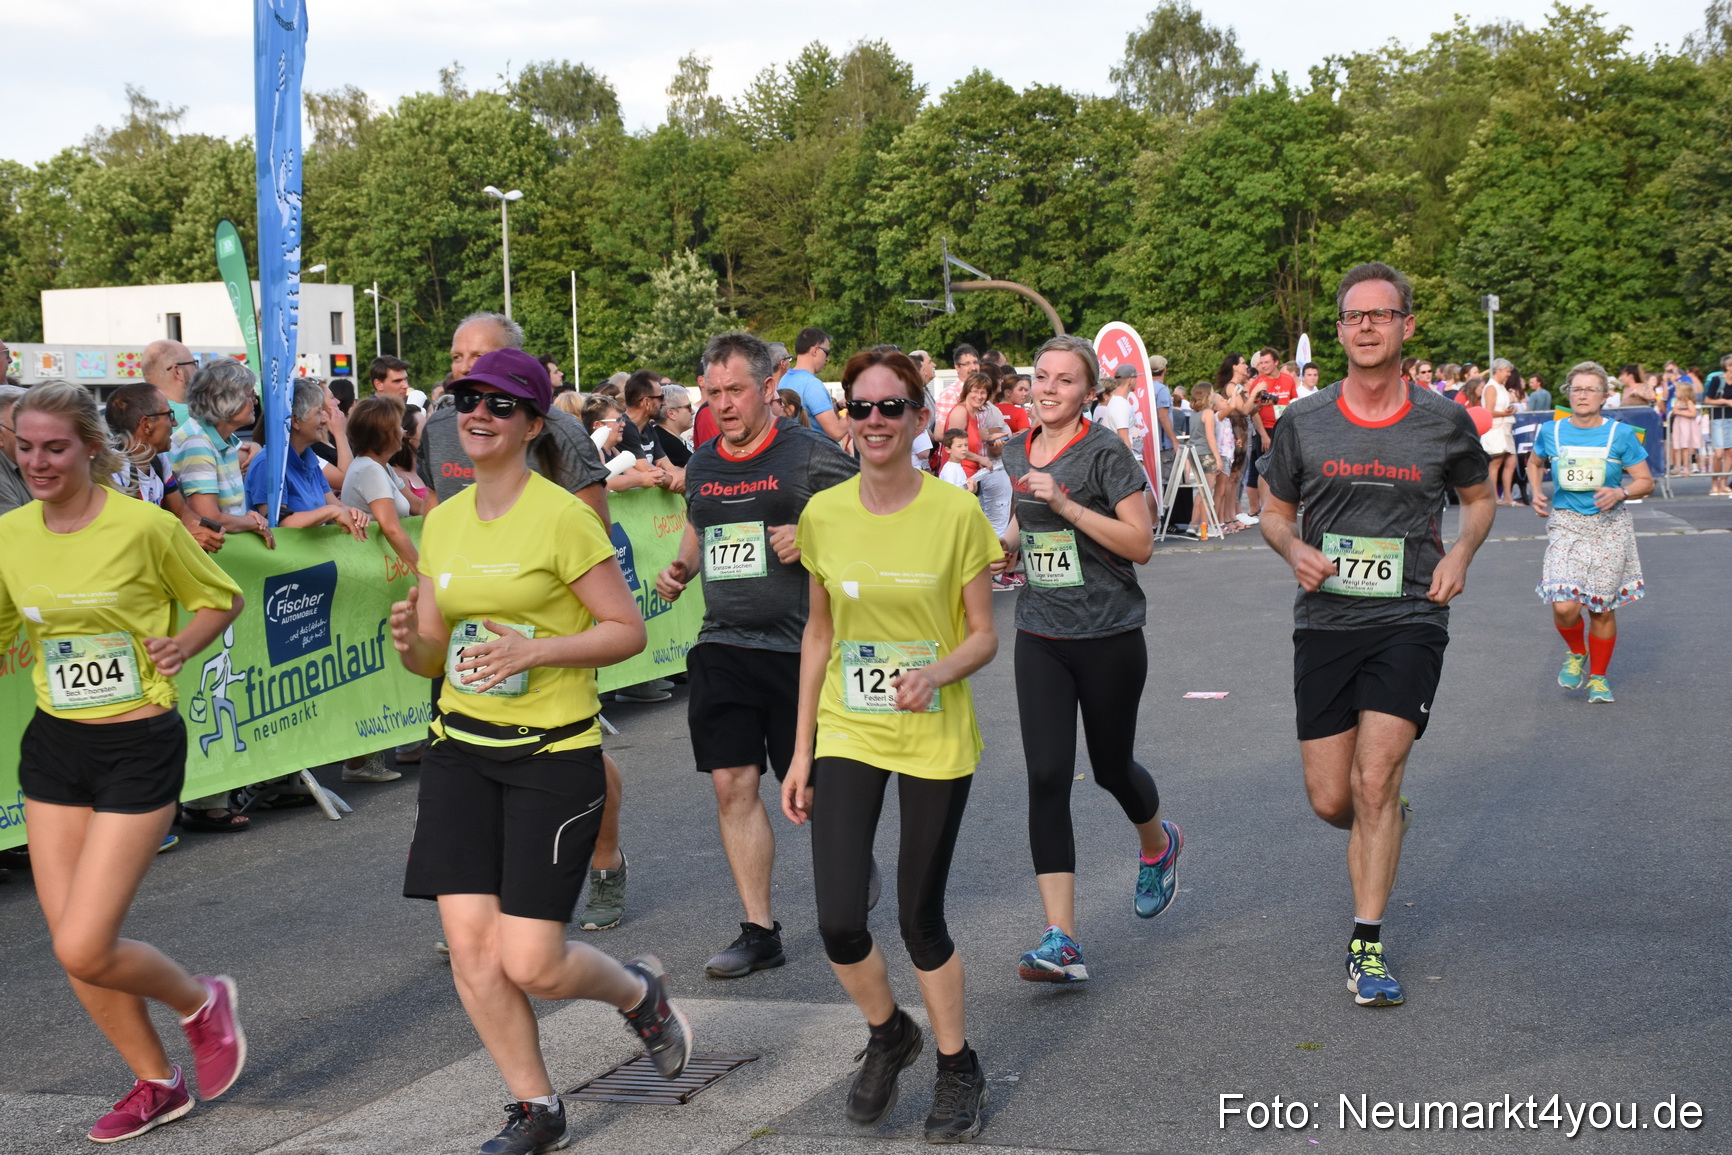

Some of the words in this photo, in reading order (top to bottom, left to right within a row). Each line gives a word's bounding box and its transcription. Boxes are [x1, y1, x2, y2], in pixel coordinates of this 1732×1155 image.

[1322, 458, 1422, 482] Oberbank
[1566, 469, 1594, 482] 834
[700, 475, 779, 496] Oberbank
[711, 542, 755, 565] 1772
[1028, 551, 1070, 572] 1774
[1332, 557, 1391, 580] 1776
[276, 593, 324, 617] Fischer
[281, 607, 318, 625] AUTOMOBILE
[56, 658, 124, 689] 1204
[246, 618, 387, 719] firmenlauf
[253, 700, 318, 742] neumarkt
